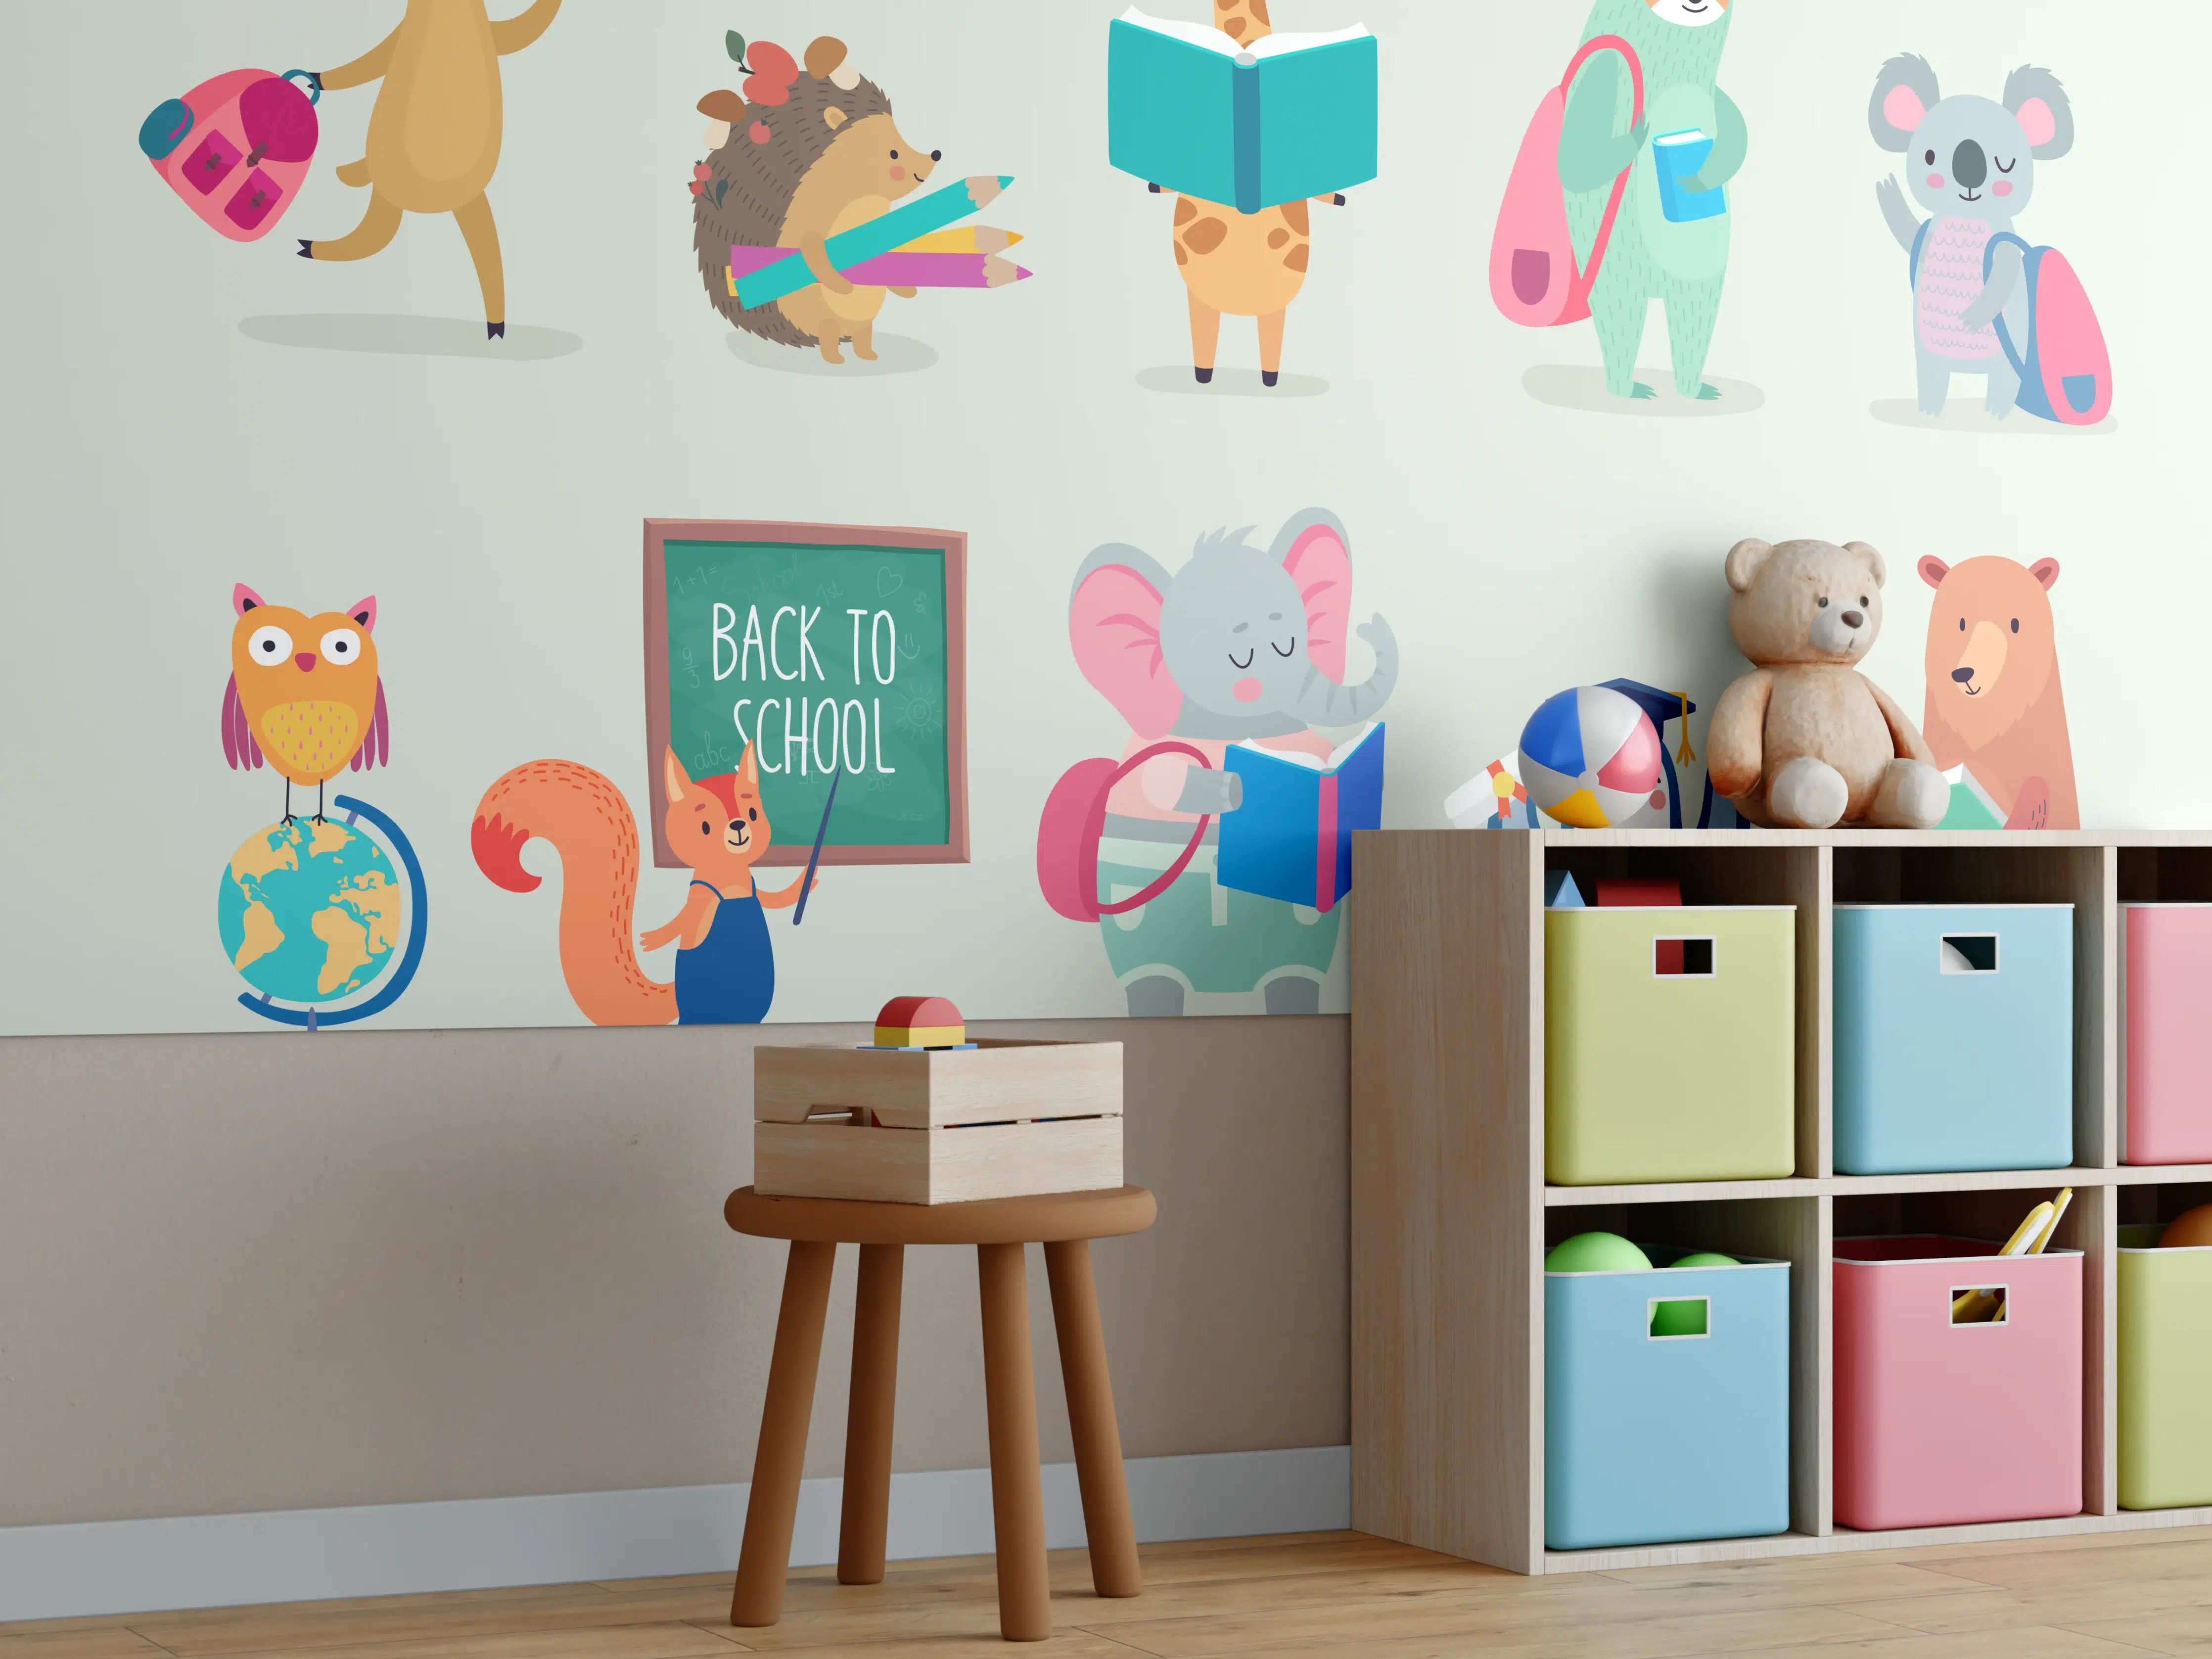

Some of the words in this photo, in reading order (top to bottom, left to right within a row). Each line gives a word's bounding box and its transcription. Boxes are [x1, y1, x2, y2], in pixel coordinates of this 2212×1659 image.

[815, 578, 844, 606] 1st
[712, 602, 826, 682] BACK
[846, 608, 896, 685] TO
[694, 730, 731, 770] abc
[733, 696, 896, 777] SCHOOL
